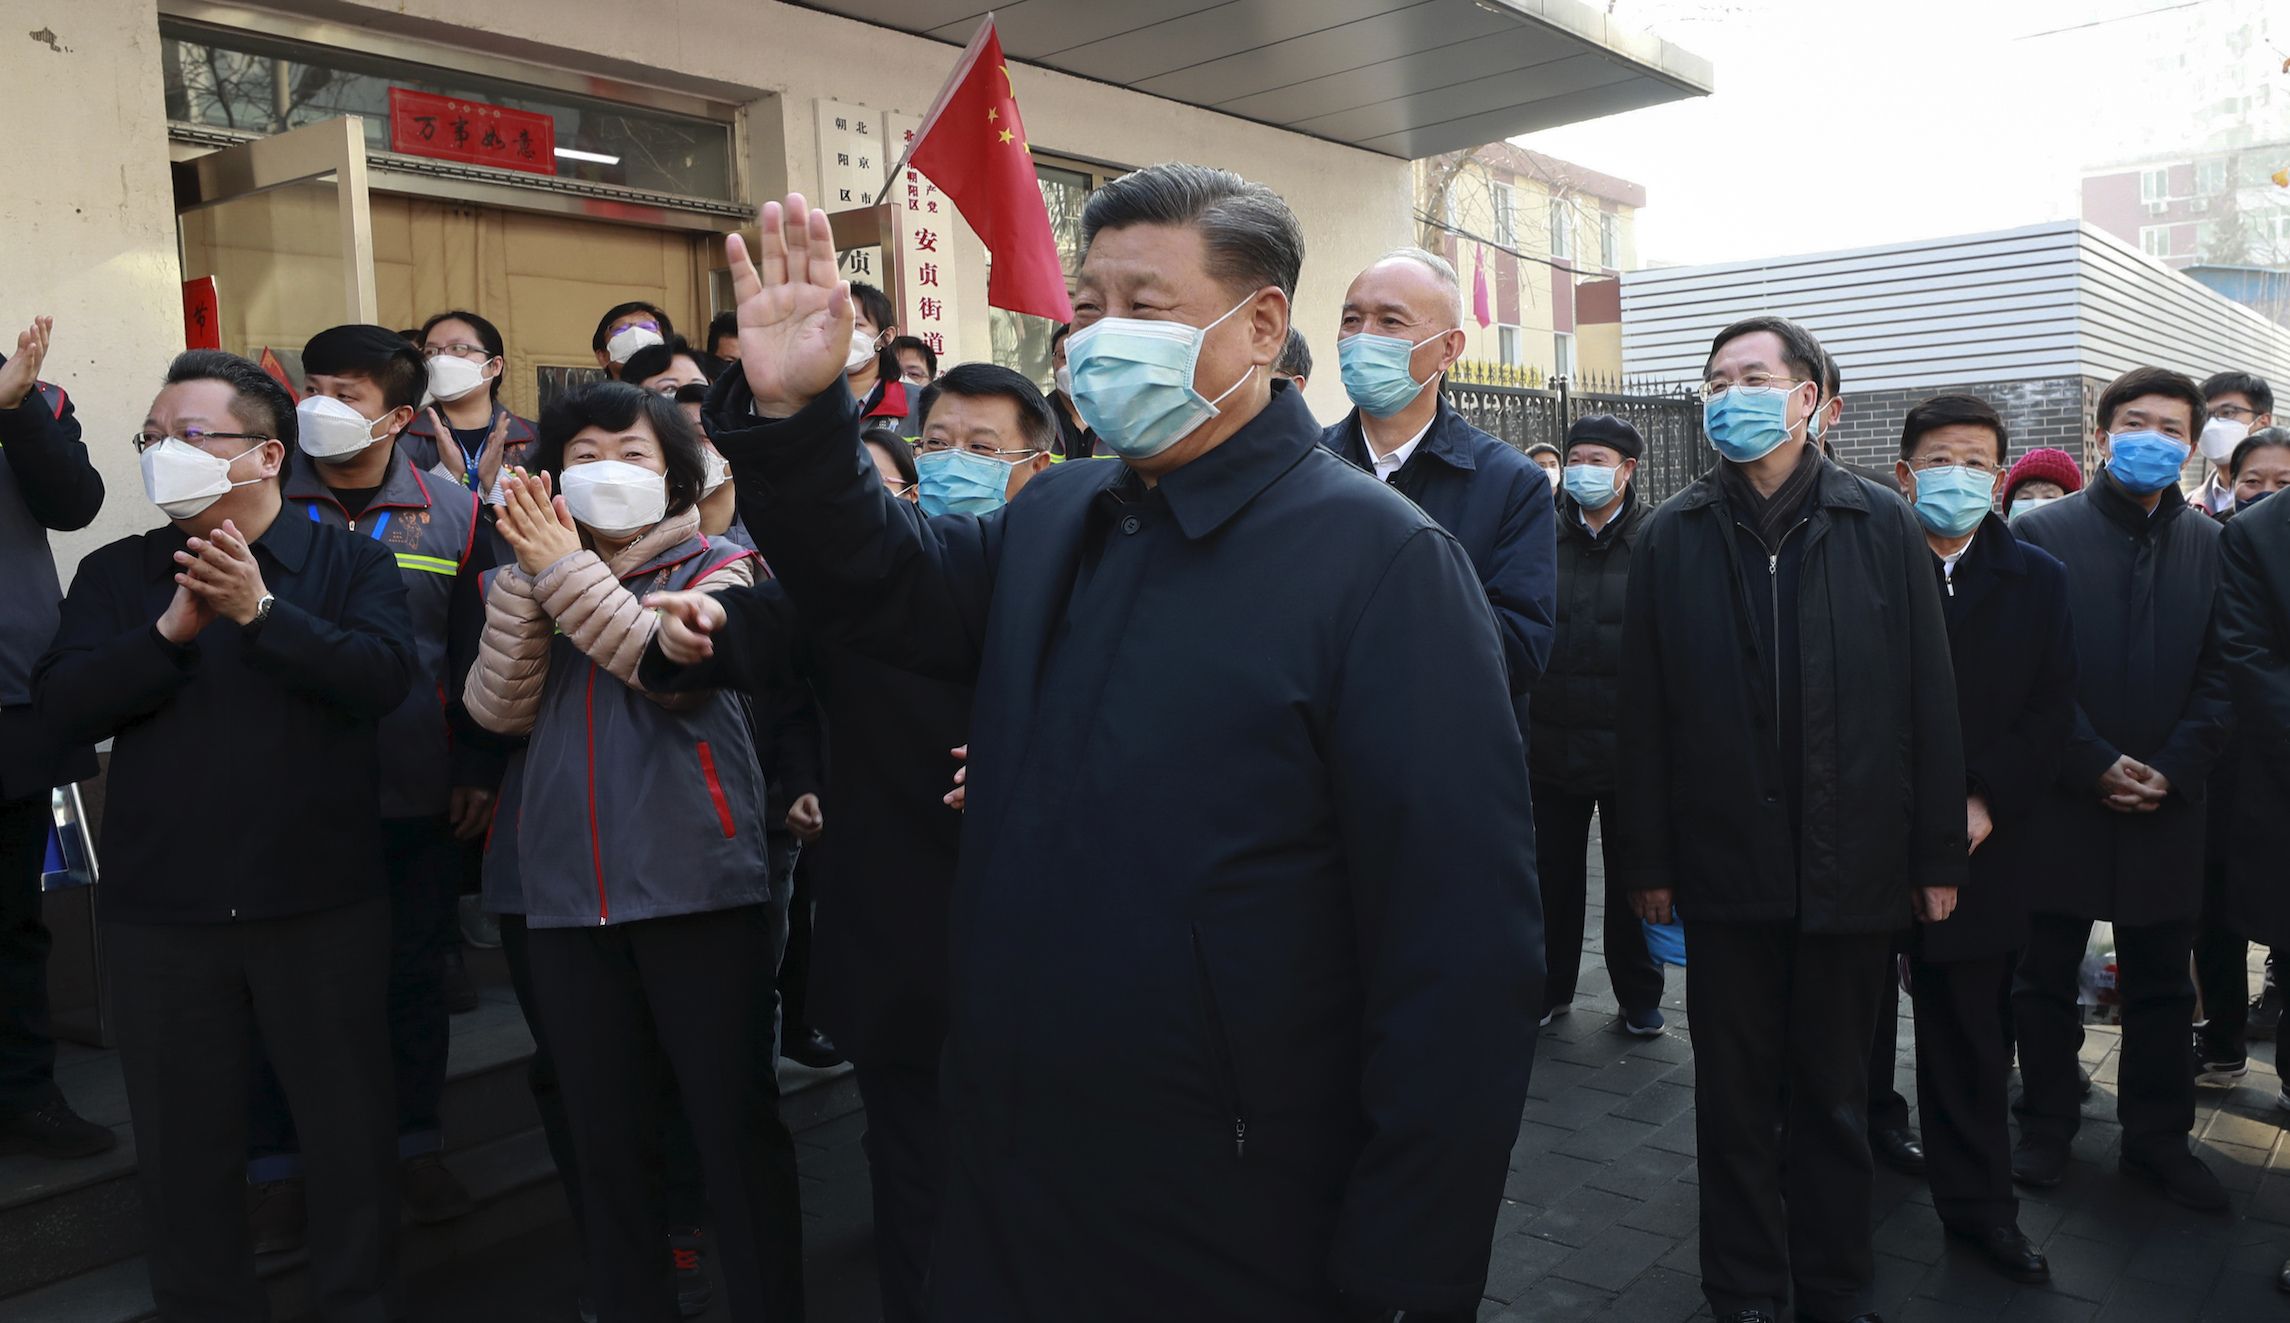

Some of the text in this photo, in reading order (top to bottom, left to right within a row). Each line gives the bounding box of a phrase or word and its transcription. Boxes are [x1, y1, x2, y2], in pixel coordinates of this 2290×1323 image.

[413, 115, 536, 160] 万事如意
[835, 117, 852, 202] 朝阳区
[856, 121, 871, 205] 北京市
[904, 129, 919, 211] 北朝阳区
[914, 228, 945, 379] 安贞街道
